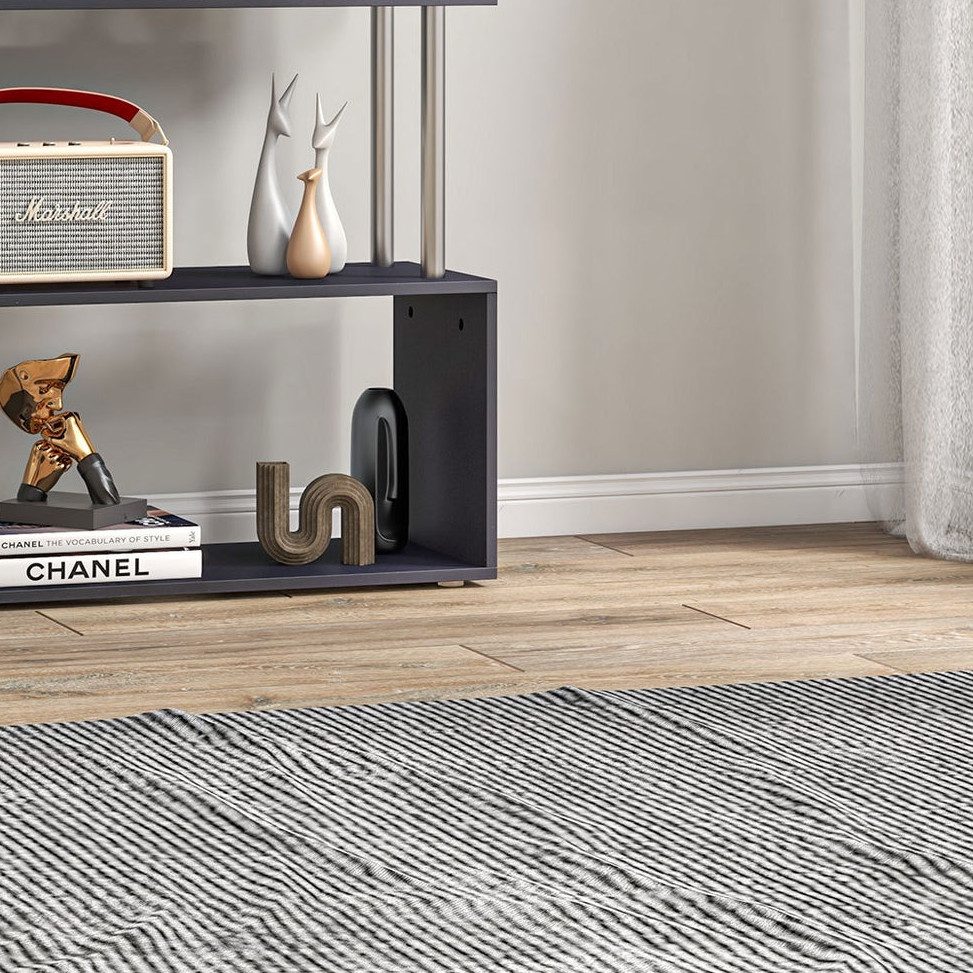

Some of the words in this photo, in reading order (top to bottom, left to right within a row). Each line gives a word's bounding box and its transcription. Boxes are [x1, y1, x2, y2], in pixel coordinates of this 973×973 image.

[15, 197, 112, 222] Marshall
[1, 540, 44, 549] CHANEL
[65, 536, 126, 546] VOCABULARY
[143, 534, 170, 543] STYLE
[26, 558, 150, 581] CHANEL
